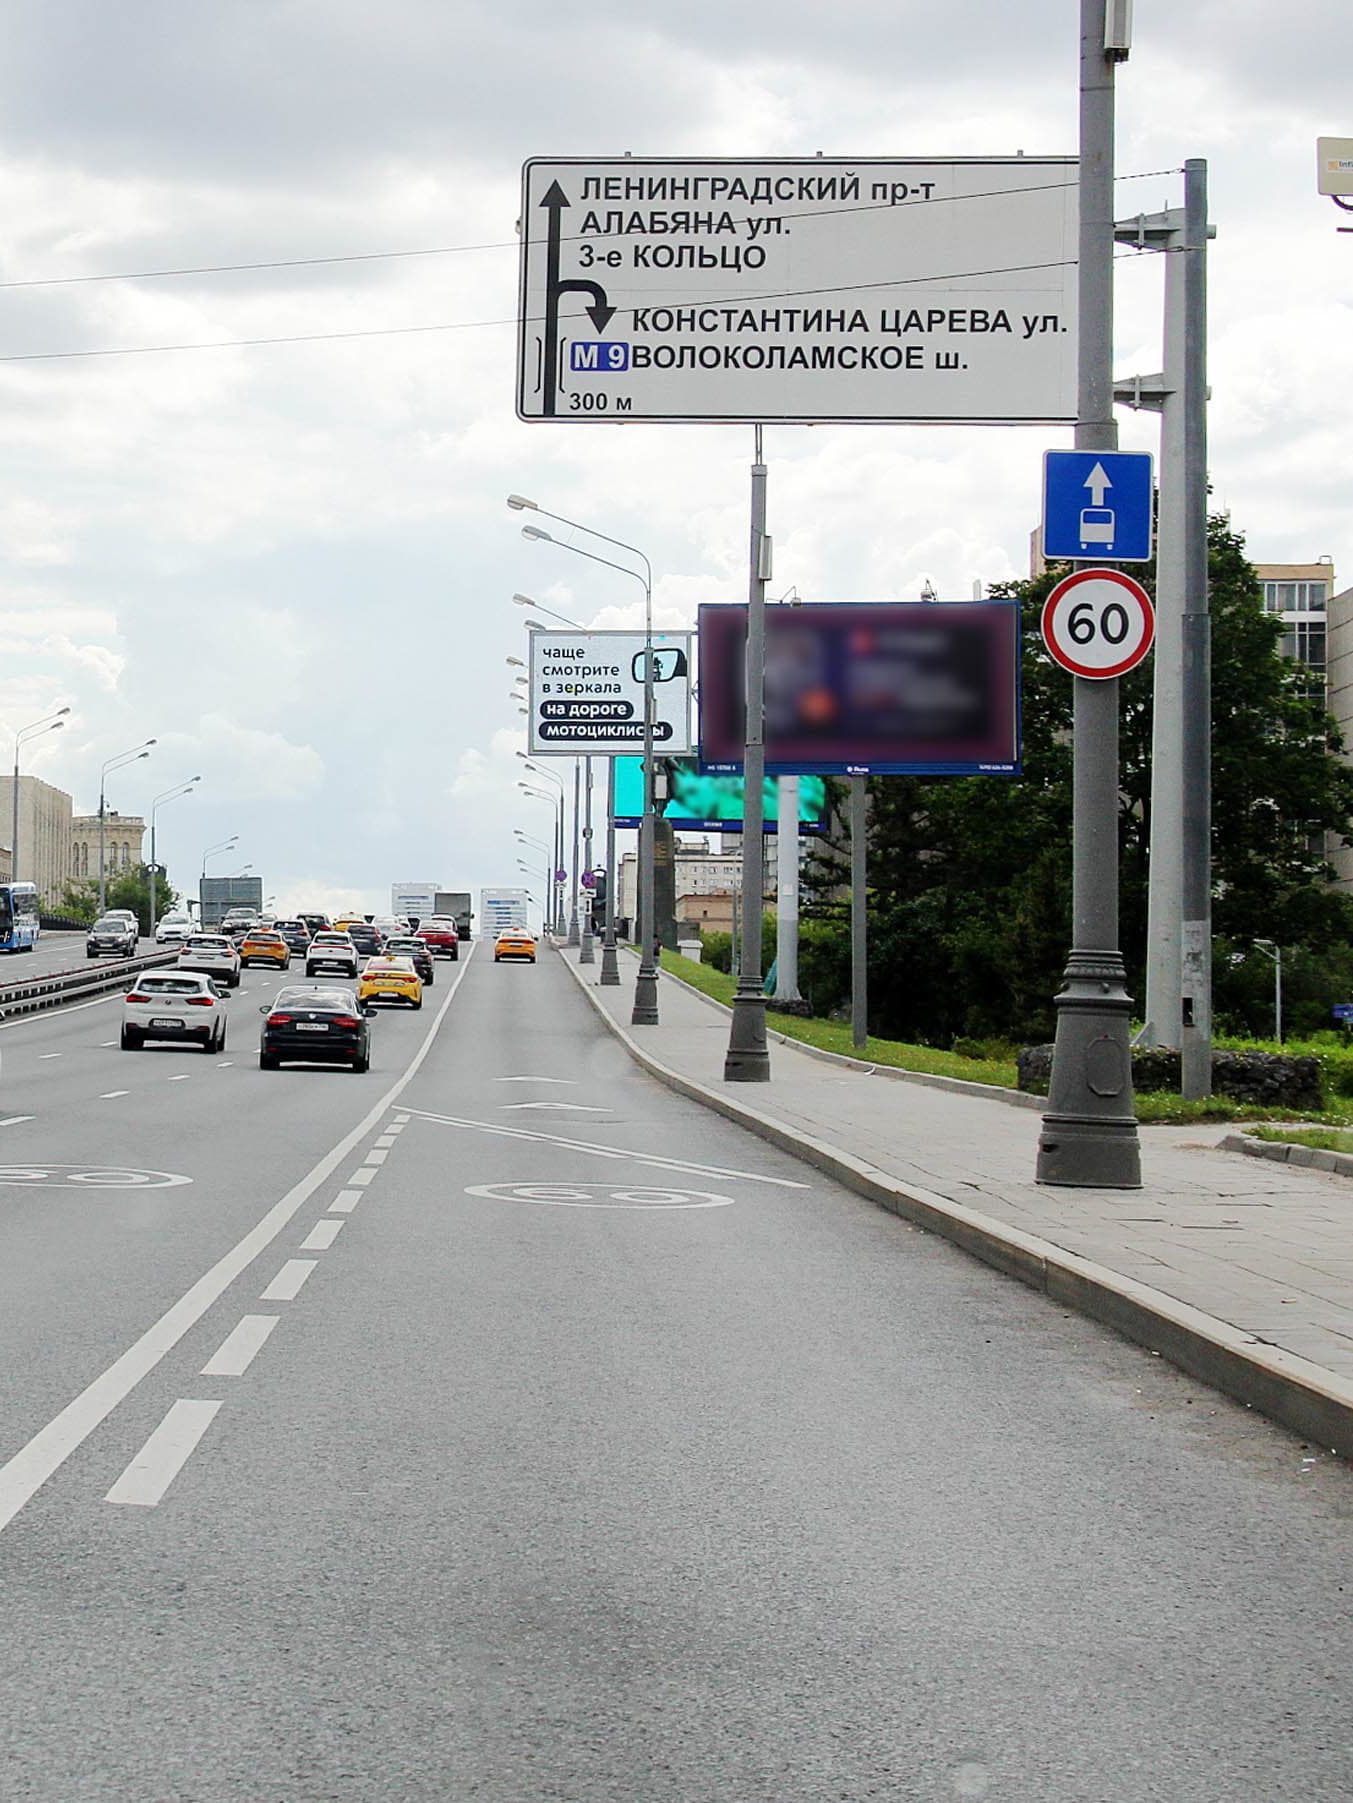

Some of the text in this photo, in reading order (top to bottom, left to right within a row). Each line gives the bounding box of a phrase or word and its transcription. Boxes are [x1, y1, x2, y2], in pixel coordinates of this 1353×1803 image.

[580, 172, 936, 207] ЛЕНИНГРАДСКИЙ пр-т
[580, 211, 792, 240] АЛАБЯНА ул.
[579, 244, 767, 271] 3-е КОЛЬЦО
[632, 308, 1068, 340] КОНСТАНТИНА ЦАРЕВА ул.
[632, 345, 968, 370] ВОЛОКОЛАМСКОЕ ш.
[569, 392, 633, 412] 300 м
[1066, 602, 1130, 646] 60
[542, 648, 585, 660] чаще
[542, 665, 620, 679] смотрите
[542, 683, 622, 697] в зеркала
[546, 704, 627, 719] на дороге
[546, 724, 665, 740] мотоциклисы
